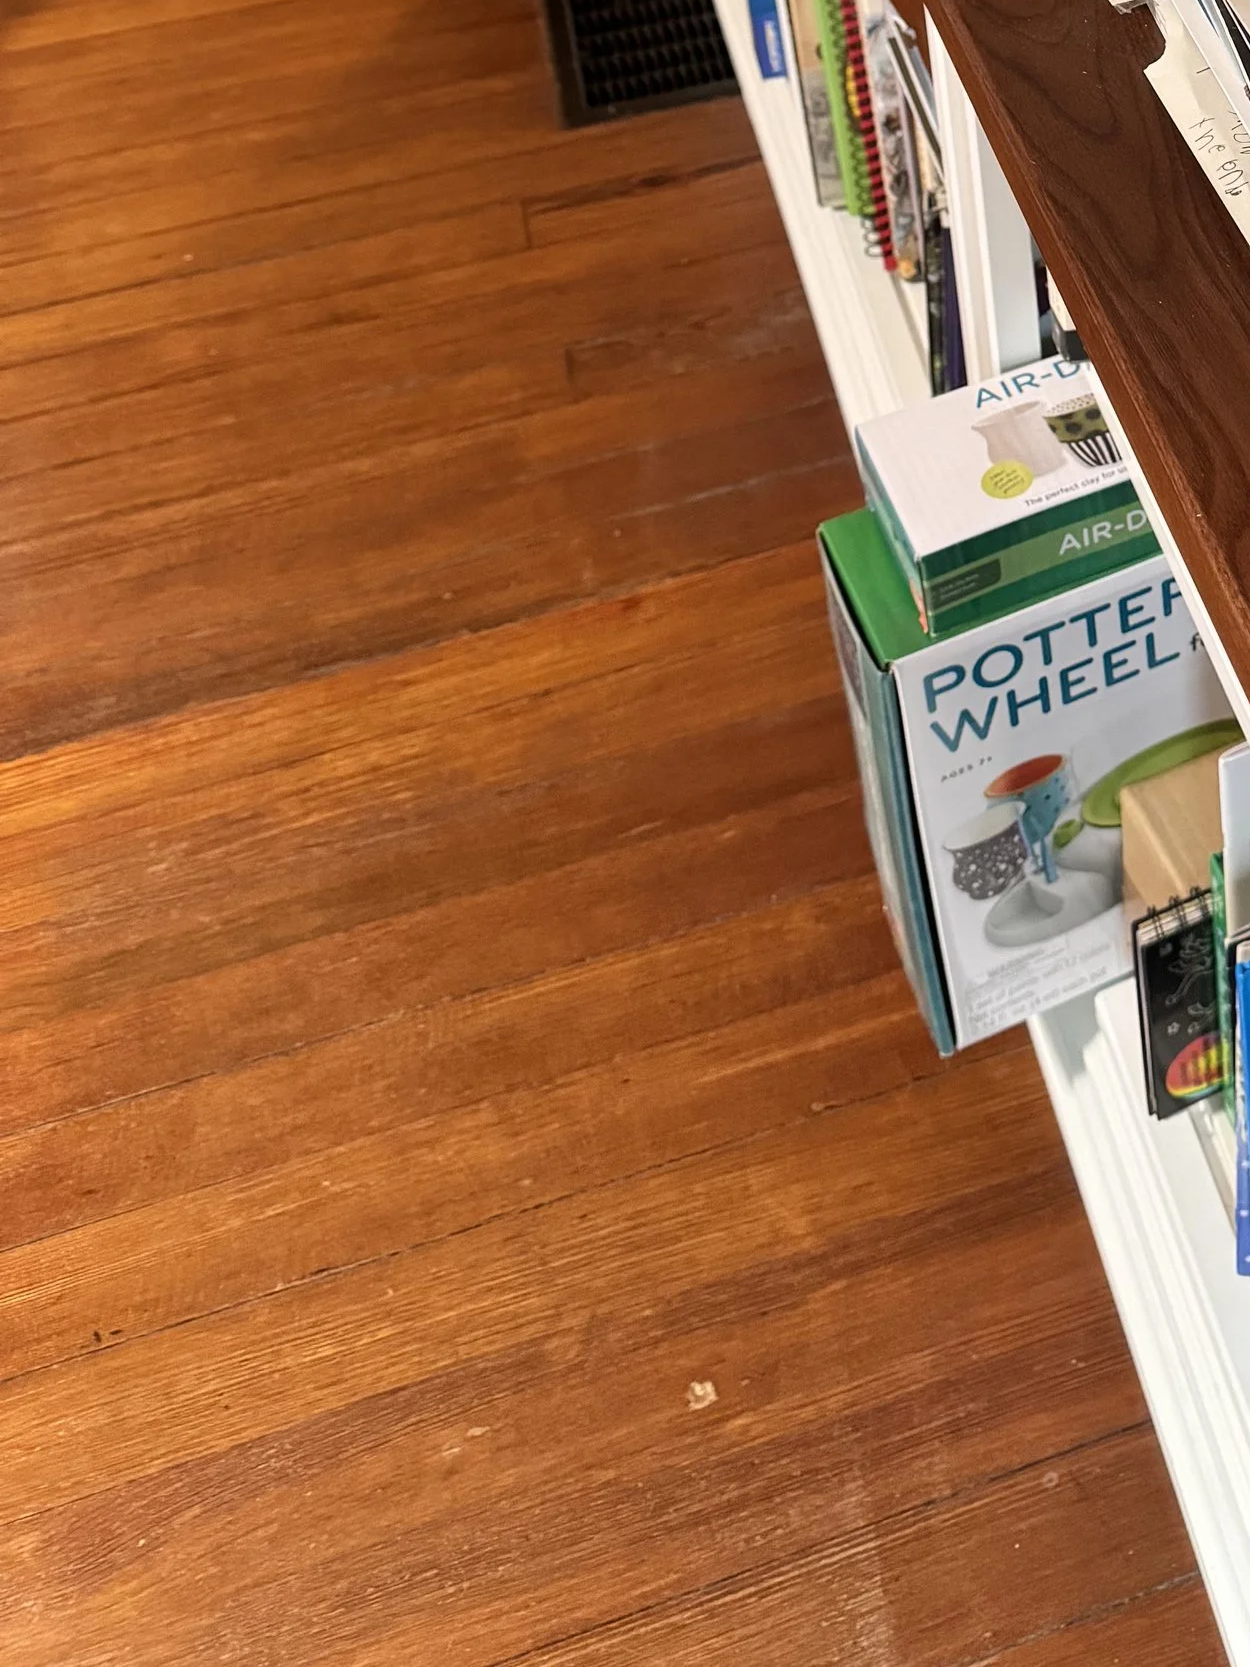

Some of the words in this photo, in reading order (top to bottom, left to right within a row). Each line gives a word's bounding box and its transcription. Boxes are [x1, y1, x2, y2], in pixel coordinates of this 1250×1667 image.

[1024, 496, 1044, 508] The
[1045, 484, 1079, 502] perfect
[1080, 476, 1100, 490] clay
[930, 632, 1180, 753] WHEEL
[941, 764, 973, 783] AGES
